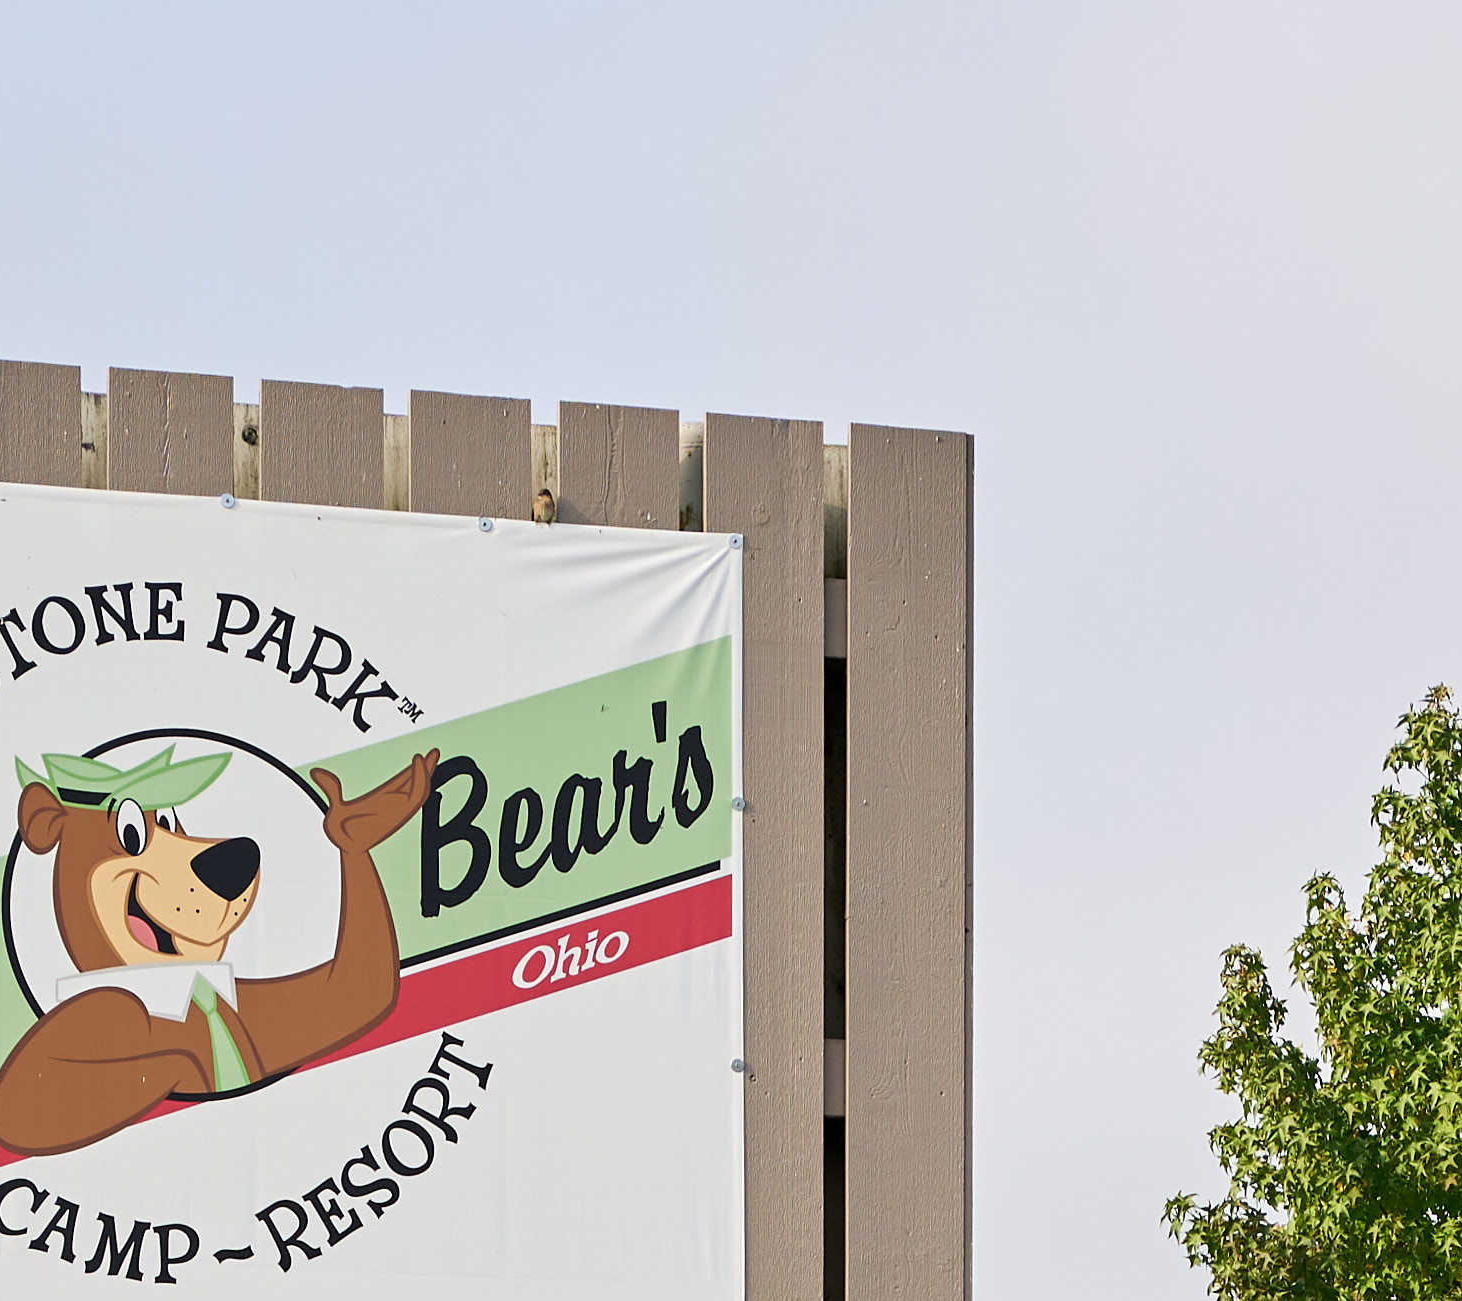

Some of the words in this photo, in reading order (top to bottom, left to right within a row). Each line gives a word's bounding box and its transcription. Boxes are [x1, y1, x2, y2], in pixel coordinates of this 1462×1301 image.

[206, 592, 402, 733] PARK
[420, 700, 715, 918] Bear's
[512, 924, 631, 991] Ohio
